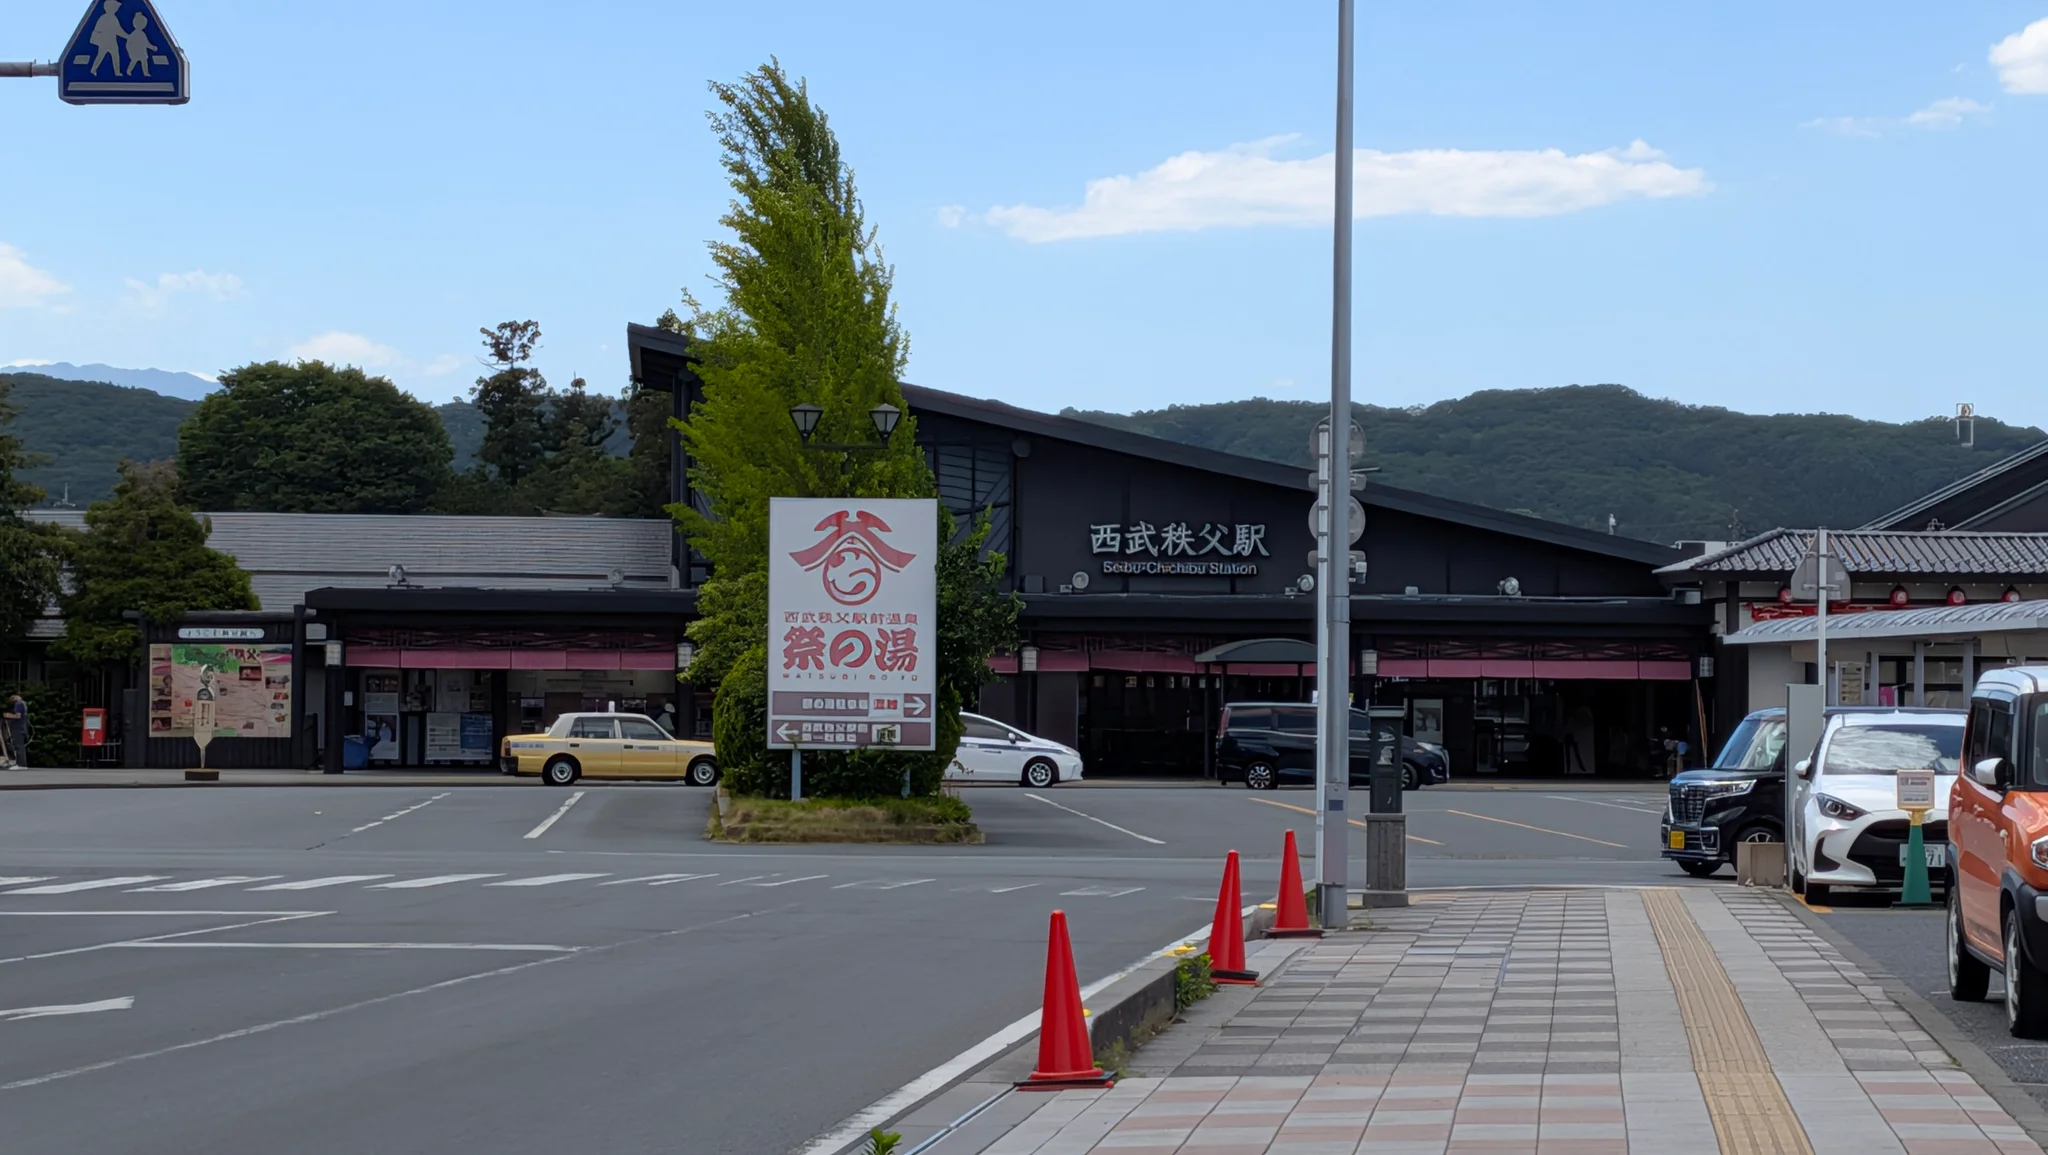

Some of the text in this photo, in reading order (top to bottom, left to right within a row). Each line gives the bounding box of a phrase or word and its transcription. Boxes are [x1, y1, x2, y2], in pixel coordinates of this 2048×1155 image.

[1090, 521, 1270, 557] 西武秩父駅
[783, 625, 919, 672] 祭の湯
